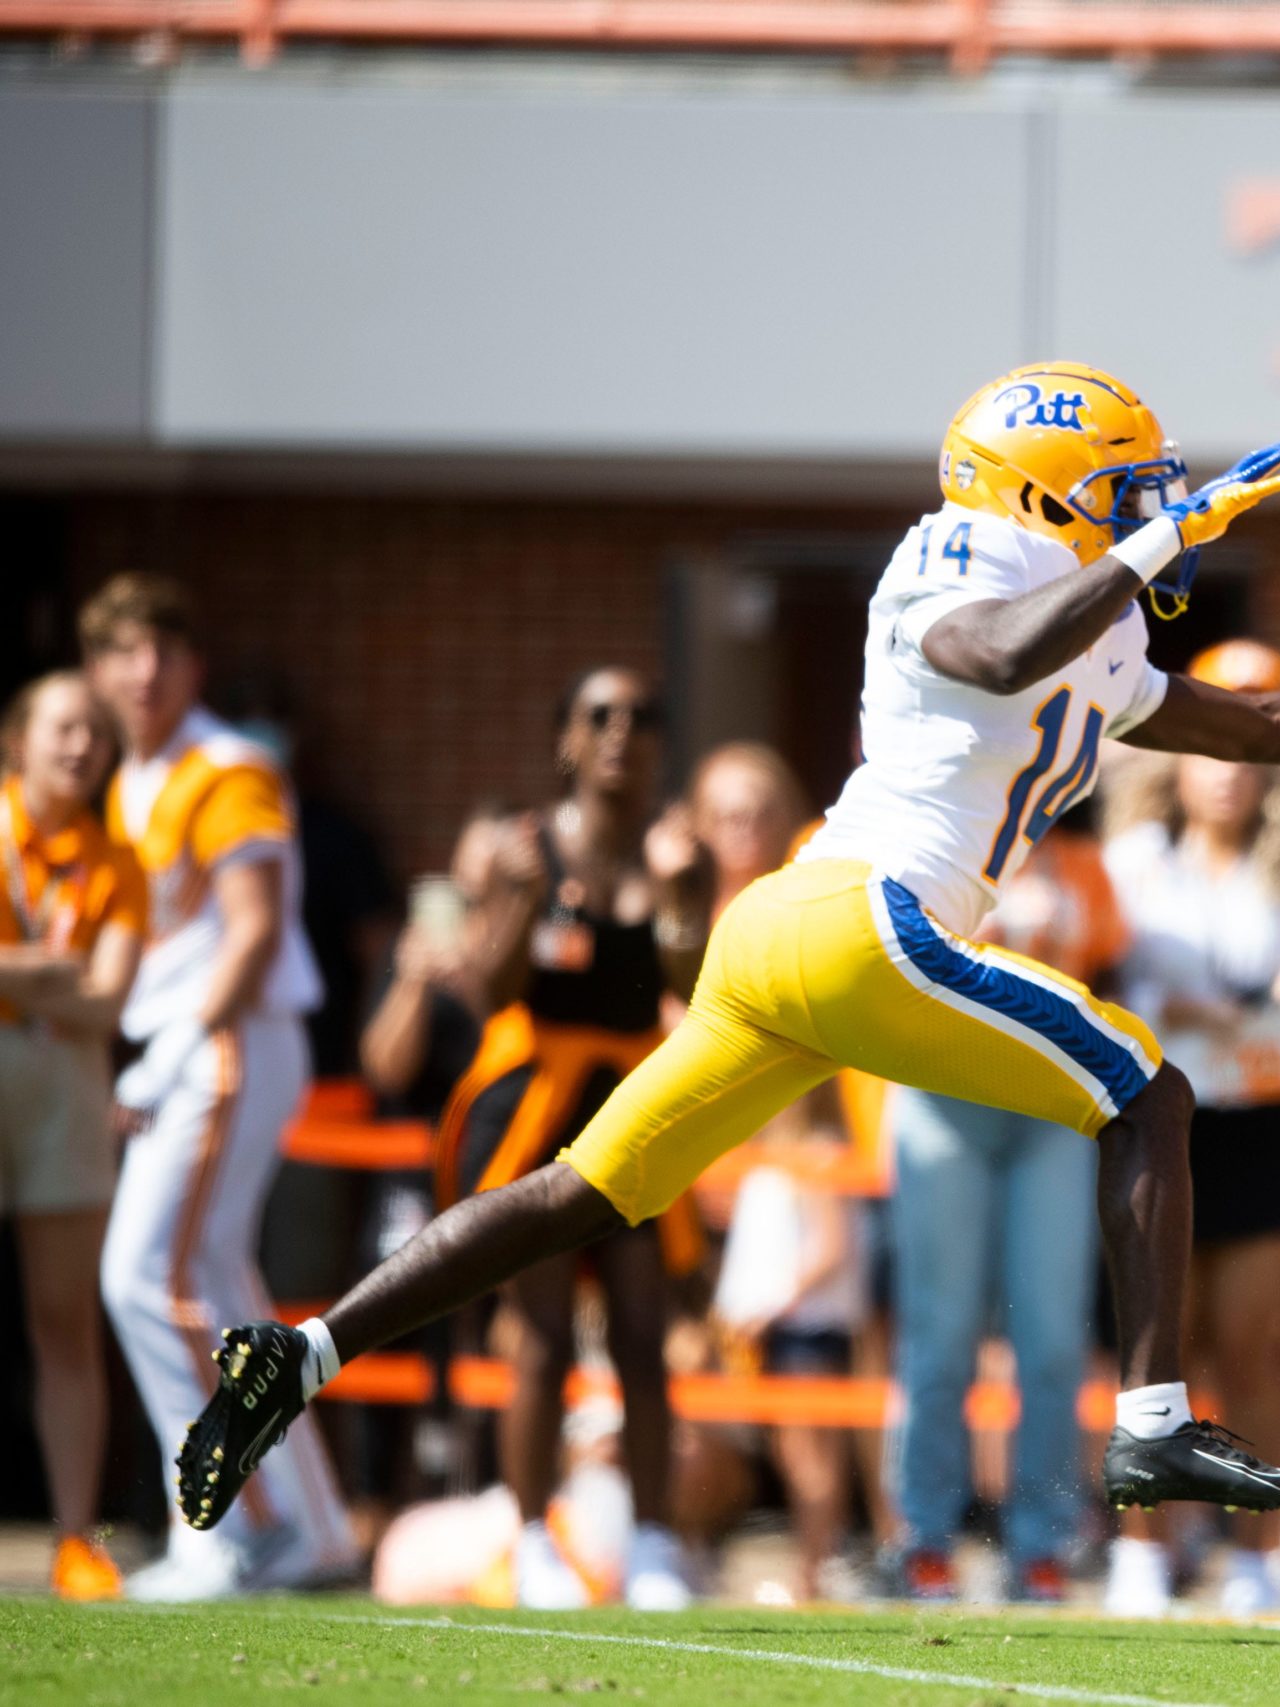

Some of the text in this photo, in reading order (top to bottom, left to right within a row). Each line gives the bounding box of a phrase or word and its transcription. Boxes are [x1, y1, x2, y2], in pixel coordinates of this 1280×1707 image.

[994, 383, 1088, 432] Pitt
[917, 521, 974, 577] 14
[982, 682, 1106, 886] 14
